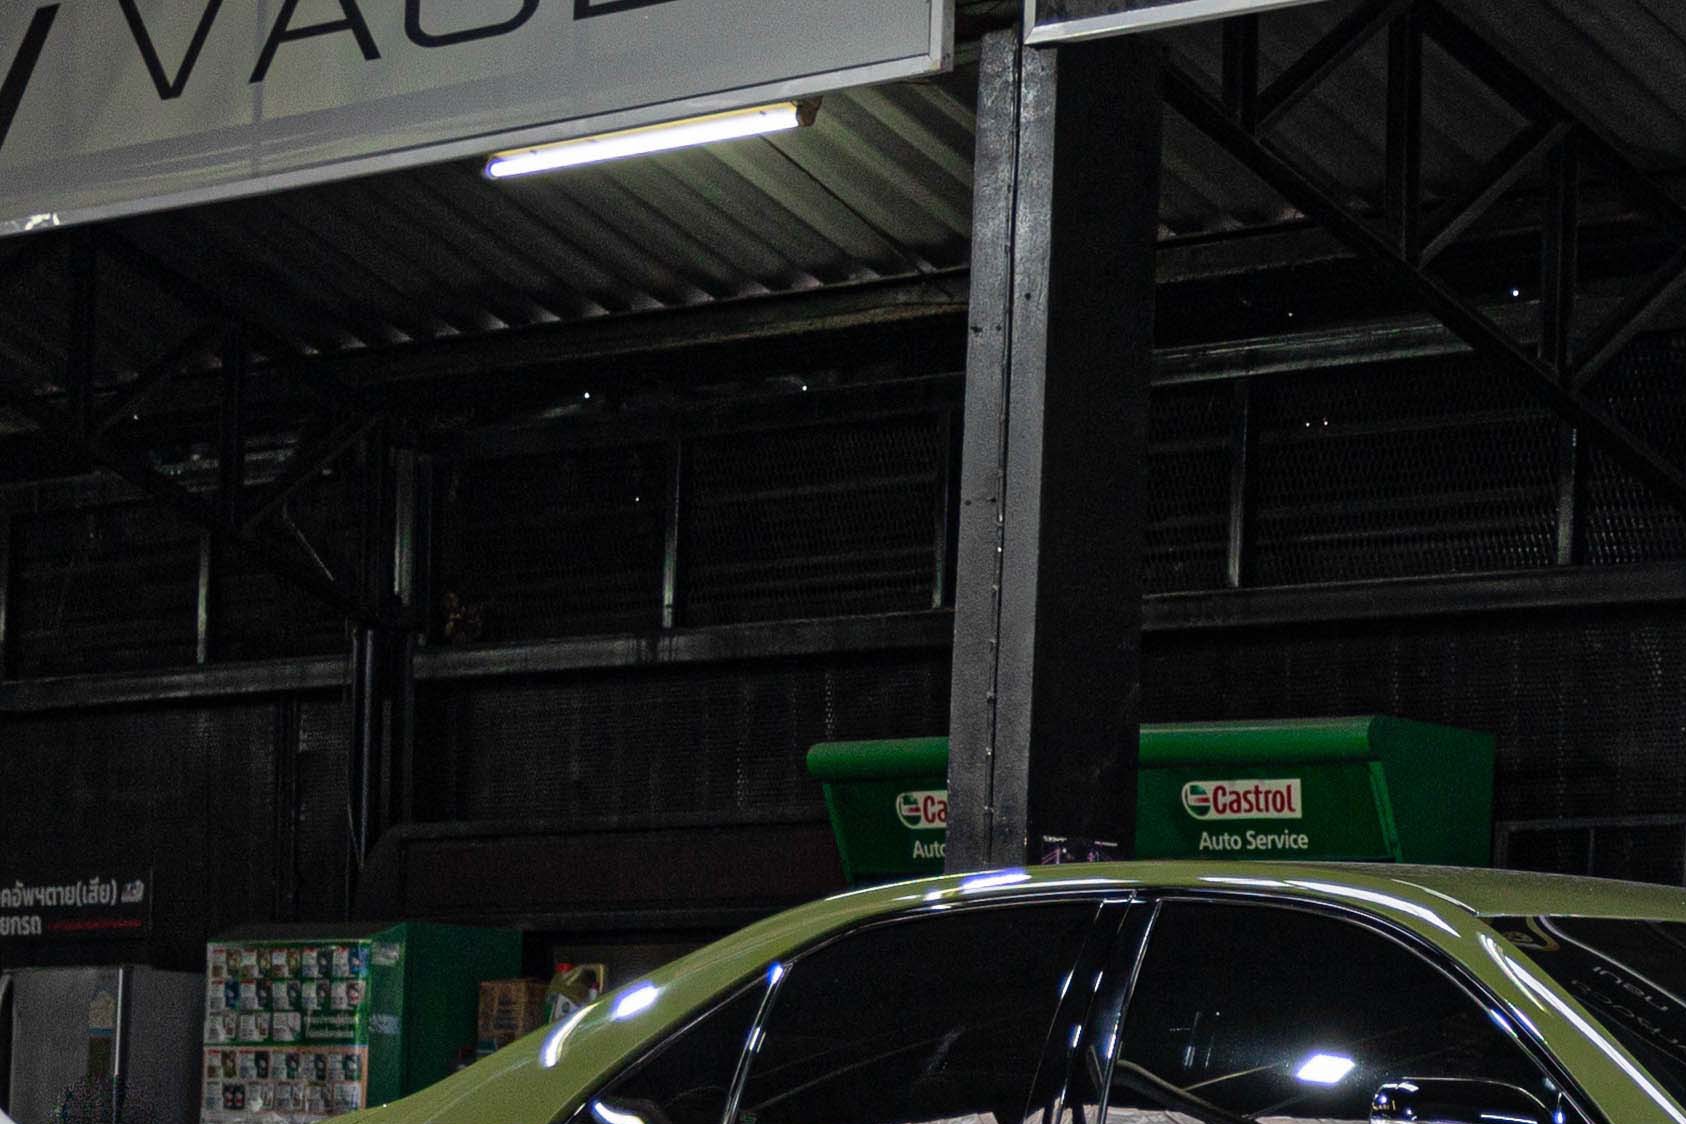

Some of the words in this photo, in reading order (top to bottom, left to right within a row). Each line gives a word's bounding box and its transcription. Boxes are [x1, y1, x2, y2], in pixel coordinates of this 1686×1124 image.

[1211, 782, 1296, 815] Castrol
[1200, 831, 1242, 851] Auto
[1246, 829, 1309, 851] Service
